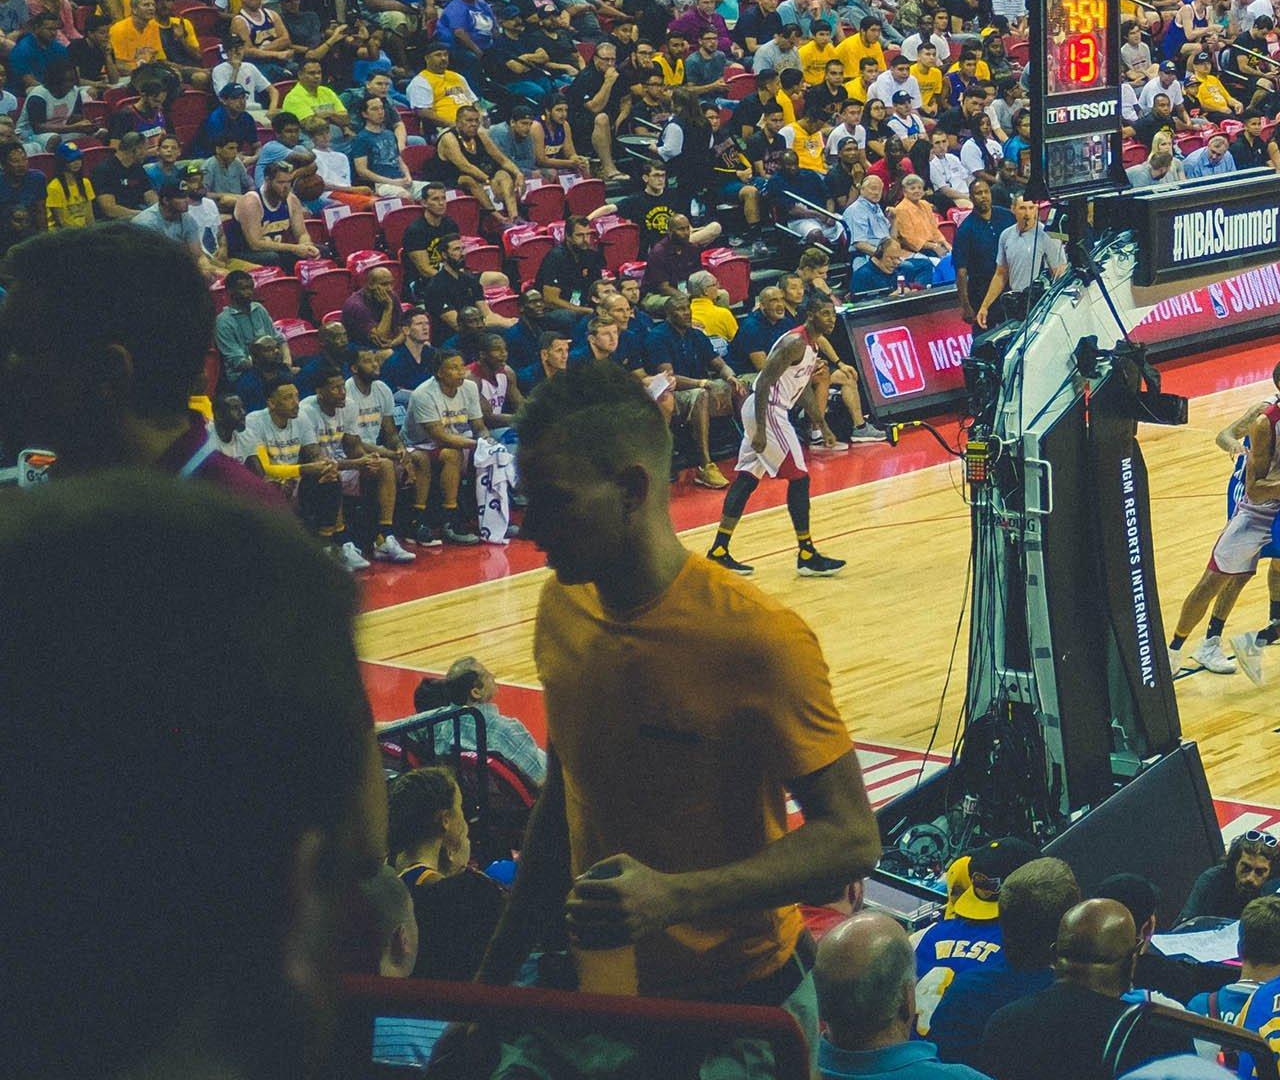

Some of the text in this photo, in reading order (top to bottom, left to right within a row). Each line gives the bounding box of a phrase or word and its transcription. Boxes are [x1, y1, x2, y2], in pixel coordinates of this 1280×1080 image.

[1069, 37, 1096, 83] 13
[1069, 100, 1118, 121] TISSOT
[1173, 207, 1279, 262] #NBASummer
[887, 340, 915, 380] TV
[1120, 457, 1152, 687] MGM RESORTS INTERNATIONAL
[934, 939, 1001, 962] WEST
